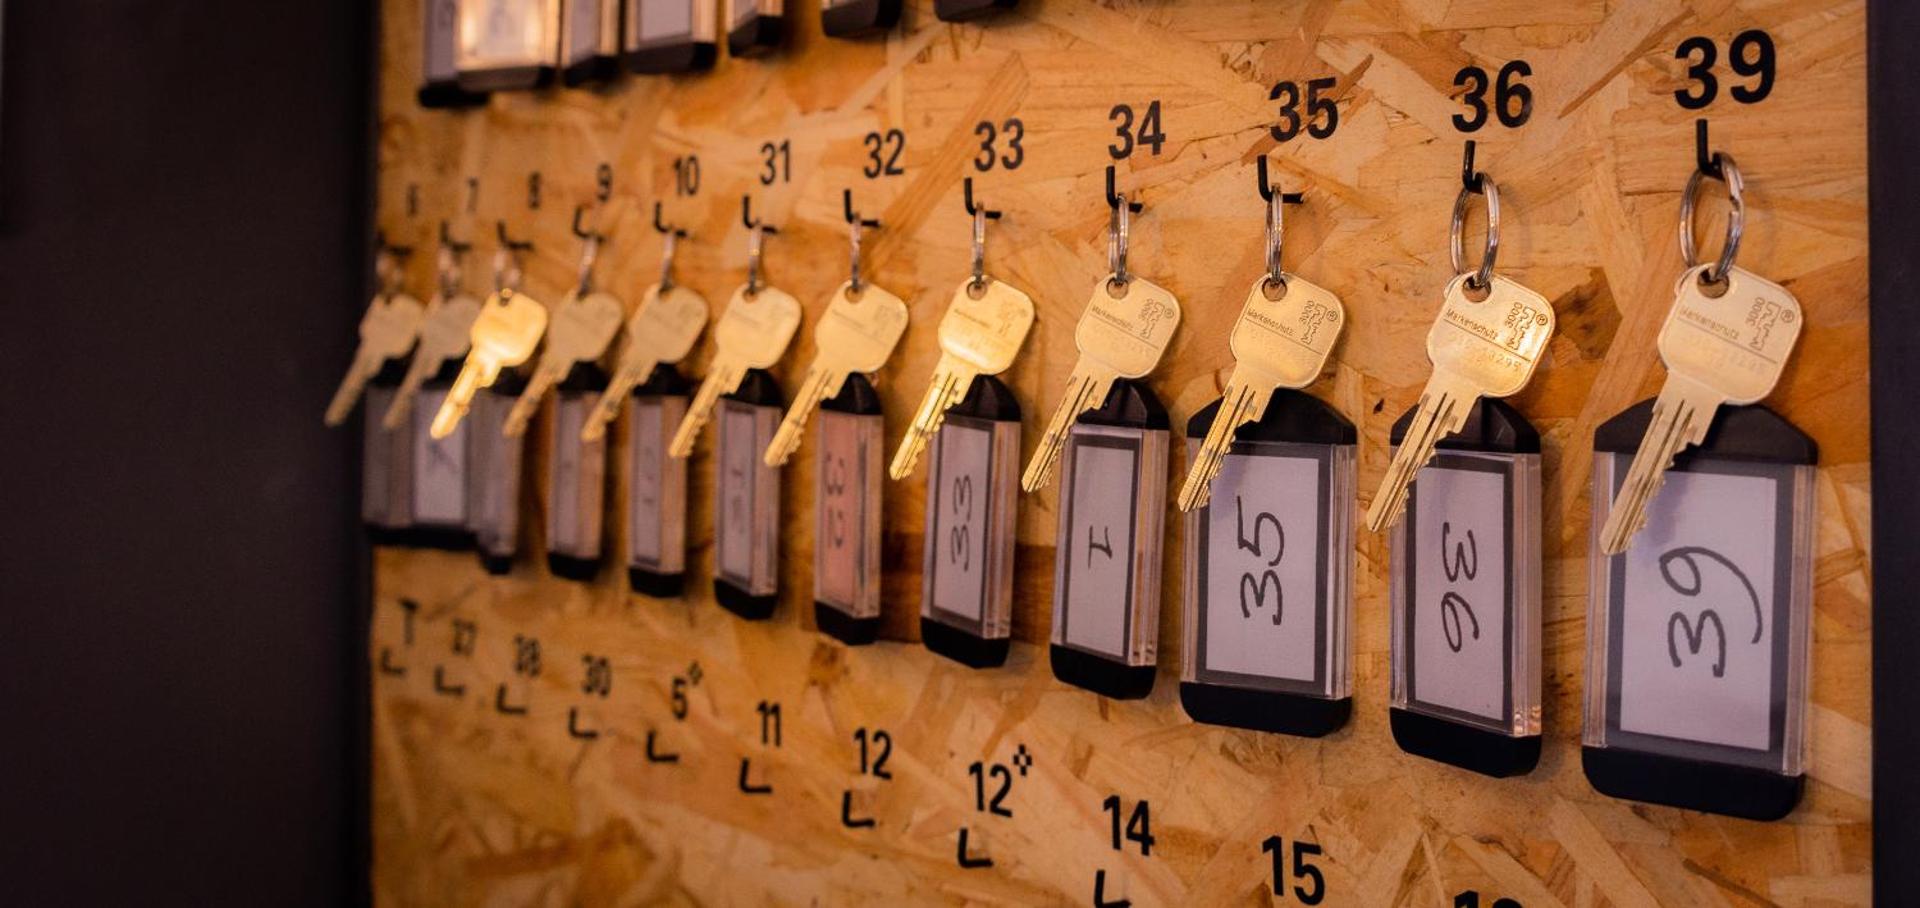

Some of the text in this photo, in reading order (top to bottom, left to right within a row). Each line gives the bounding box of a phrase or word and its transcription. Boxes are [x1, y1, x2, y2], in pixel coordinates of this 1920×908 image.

[1449, 59, 1533, 133] 36
[1673, 29, 1777, 110] 39
[1108, 100, 1166, 161] 34
[1267, 76, 1340, 143] 35
[760, 140, 790, 186] 31
[863, 128, 905, 179] 32
[975, 119, 1025, 173] 33
[528, 171, 542, 210] 8
[596, 164, 612, 203] 9
[672, 155, 700, 196] 10
[1446, 308, 1499, 341] Markenschutz
[1504, 301, 1523, 328] 3000
[1745, 297, 1765, 326] 3000
[950, 474, 973, 572] 33
[1236, 495, 1285, 626] 35
[1440, 521, 1480, 653] 36
[1658, 546, 1763, 679] 39
[581, 654, 612, 698] 30
[757, 700, 781, 747] 11
[854, 727, 893, 781] 12
[1103, 794, 1156, 858] 14
[1261, 835, 1326, 906] 15
